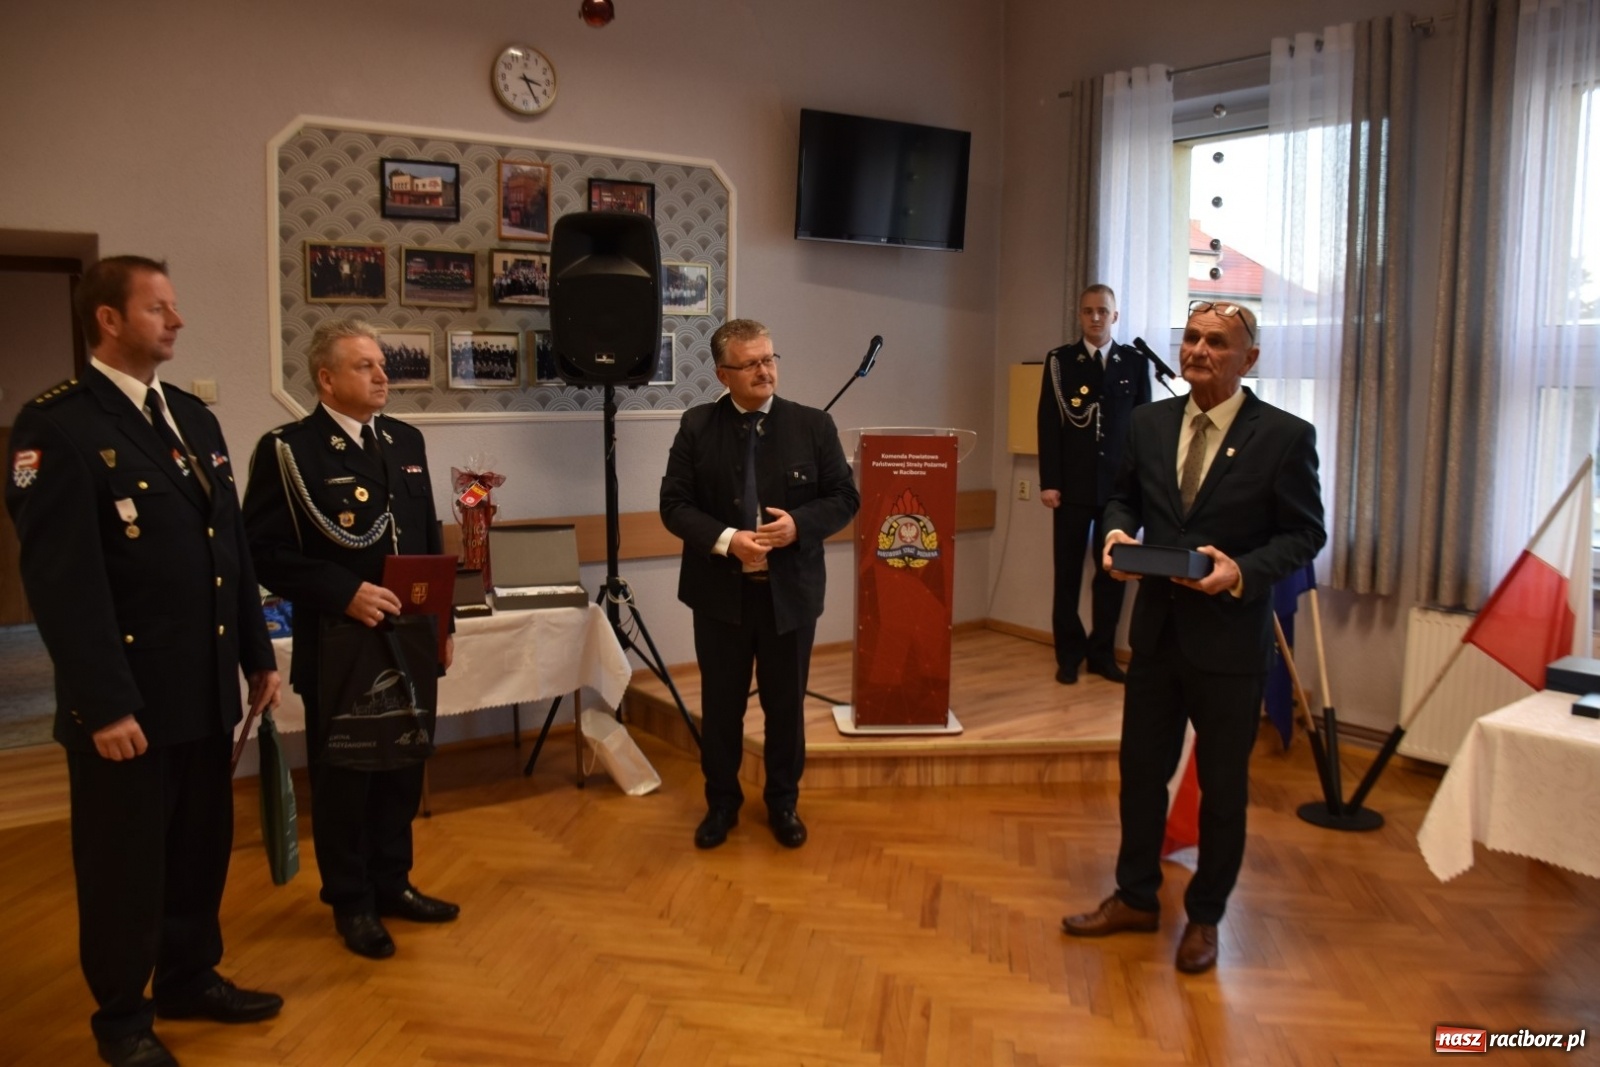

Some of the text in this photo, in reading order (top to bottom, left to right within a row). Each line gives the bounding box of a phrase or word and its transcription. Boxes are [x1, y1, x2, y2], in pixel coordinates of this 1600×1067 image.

[501, 60, 512, 71] 10
[542, 67, 548, 75] 2
[501, 72, 507, 81] 9
[545, 79, 550, 87] 3
[503, 83, 509, 92] 8
[512, 93, 518, 101] 7
